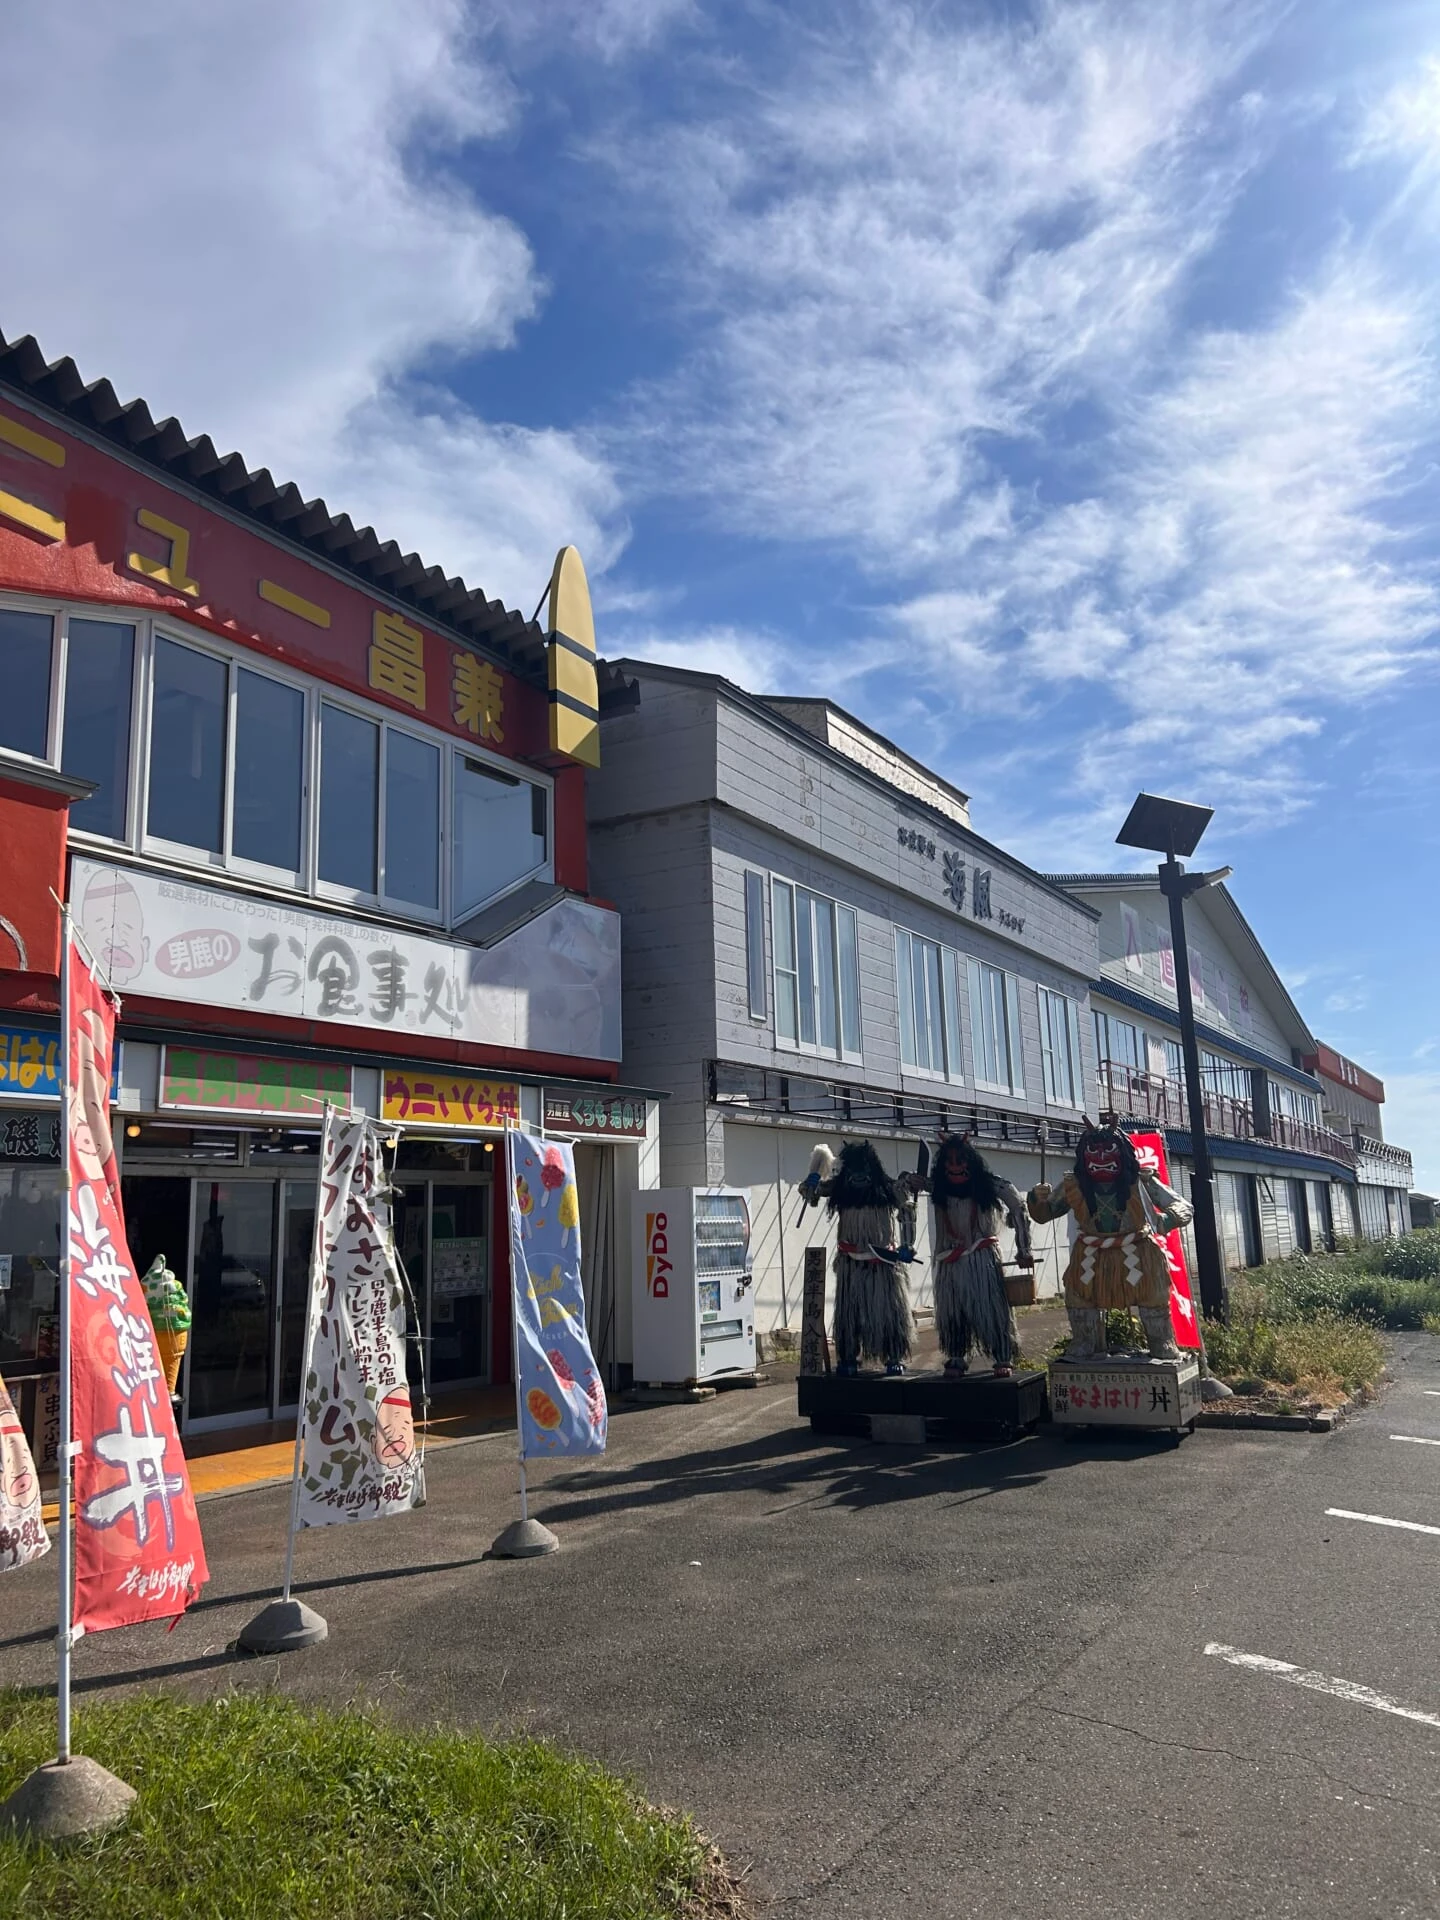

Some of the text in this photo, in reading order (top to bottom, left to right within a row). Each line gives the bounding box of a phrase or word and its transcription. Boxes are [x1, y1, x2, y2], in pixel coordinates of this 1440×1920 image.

[168, 932, 469, 1030] 男鹿の お食事処
[386, 1076, 518, 1126] ウニいくら丼
[653, 1212, 673, 1299] DyDo
[347, 1283, 375, 1385] ブレンド粉末
[370, 1279, 397, 1385] 男鹿半島の塩
[802, 1250, 823, 1374] 男鹿半島入道崎
[70, 1183, 184, 1553] 海鮮丼
[1054, 1383, 1070, 1413] 海鮮
[310, 1475, 409, 1512] なまはげ御殿
